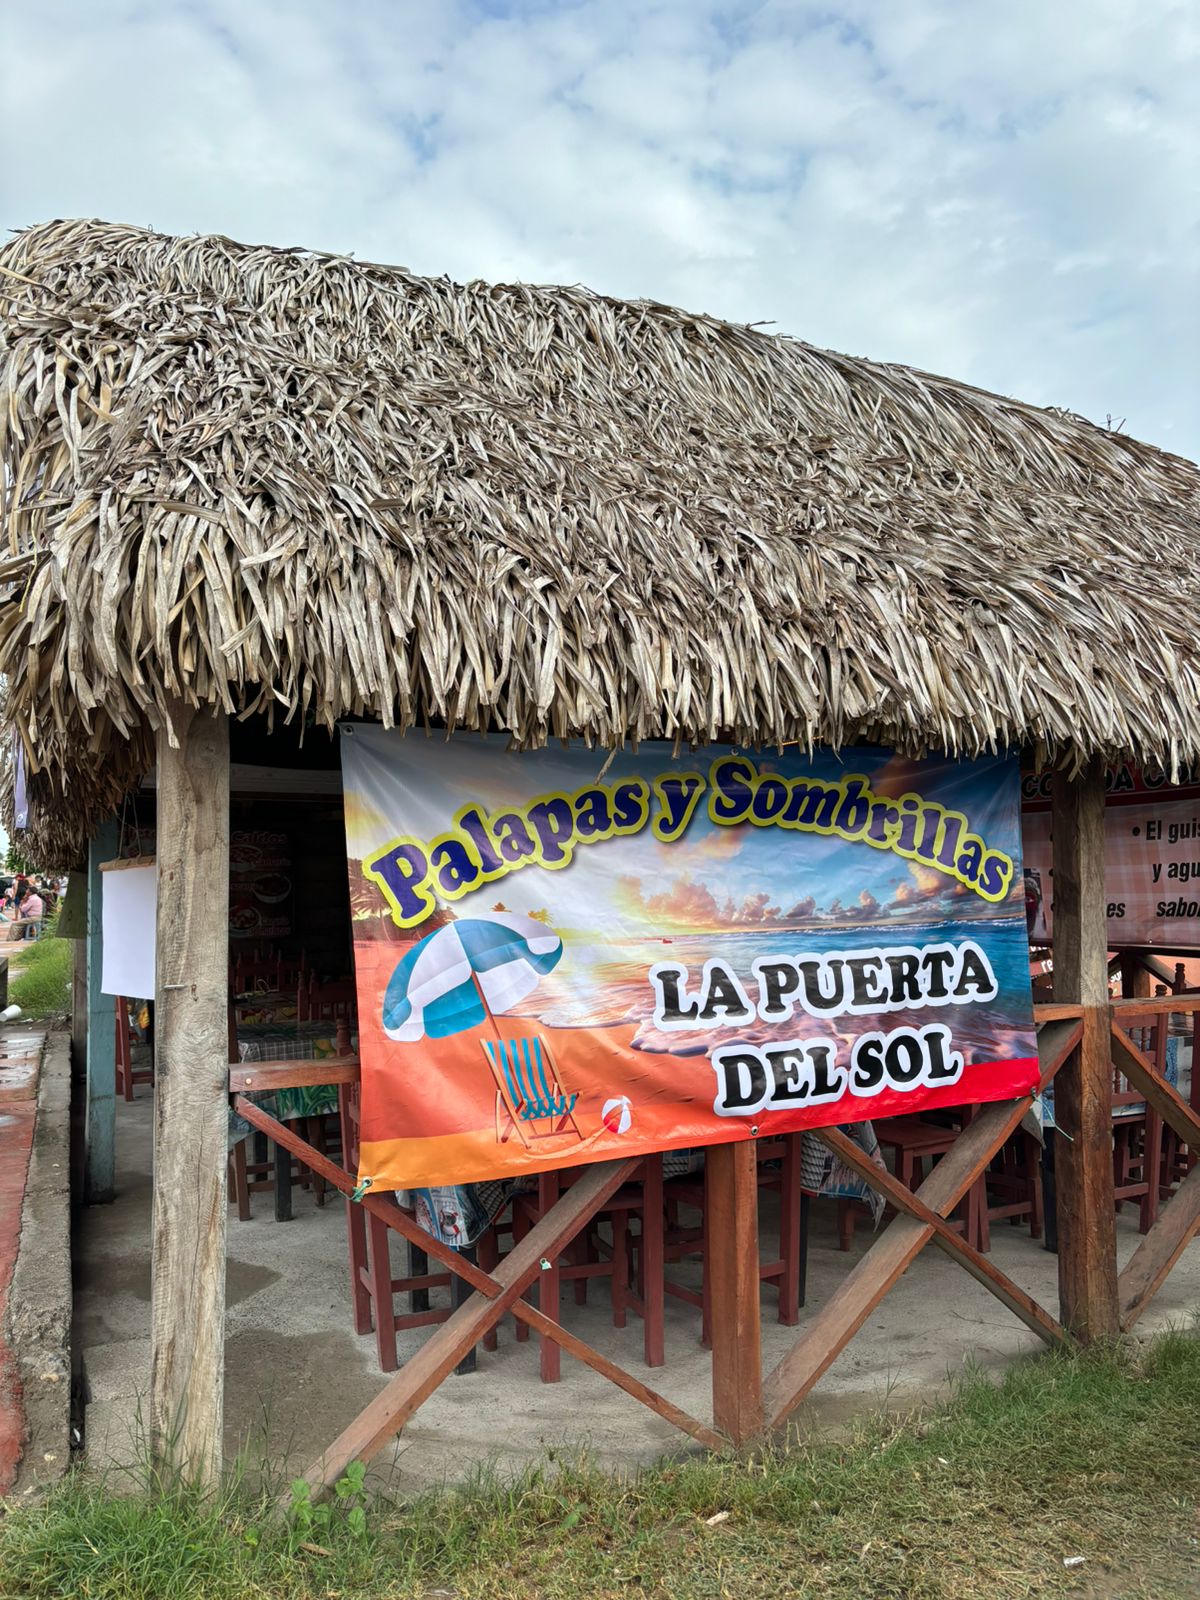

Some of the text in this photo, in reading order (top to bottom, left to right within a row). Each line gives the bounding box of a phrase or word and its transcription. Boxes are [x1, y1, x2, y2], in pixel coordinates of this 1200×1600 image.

[366, 759, 1011, 924] Palapas y Sombrillas
[1146, 820, 1162, 840] El
[1152, 864, 1162, 883] y
[1156, 897, 1200, 918] sabo
[652, 945, 996, 1026] LA PUERTA
[715, 1027, 962, 1113] DEL SOL
